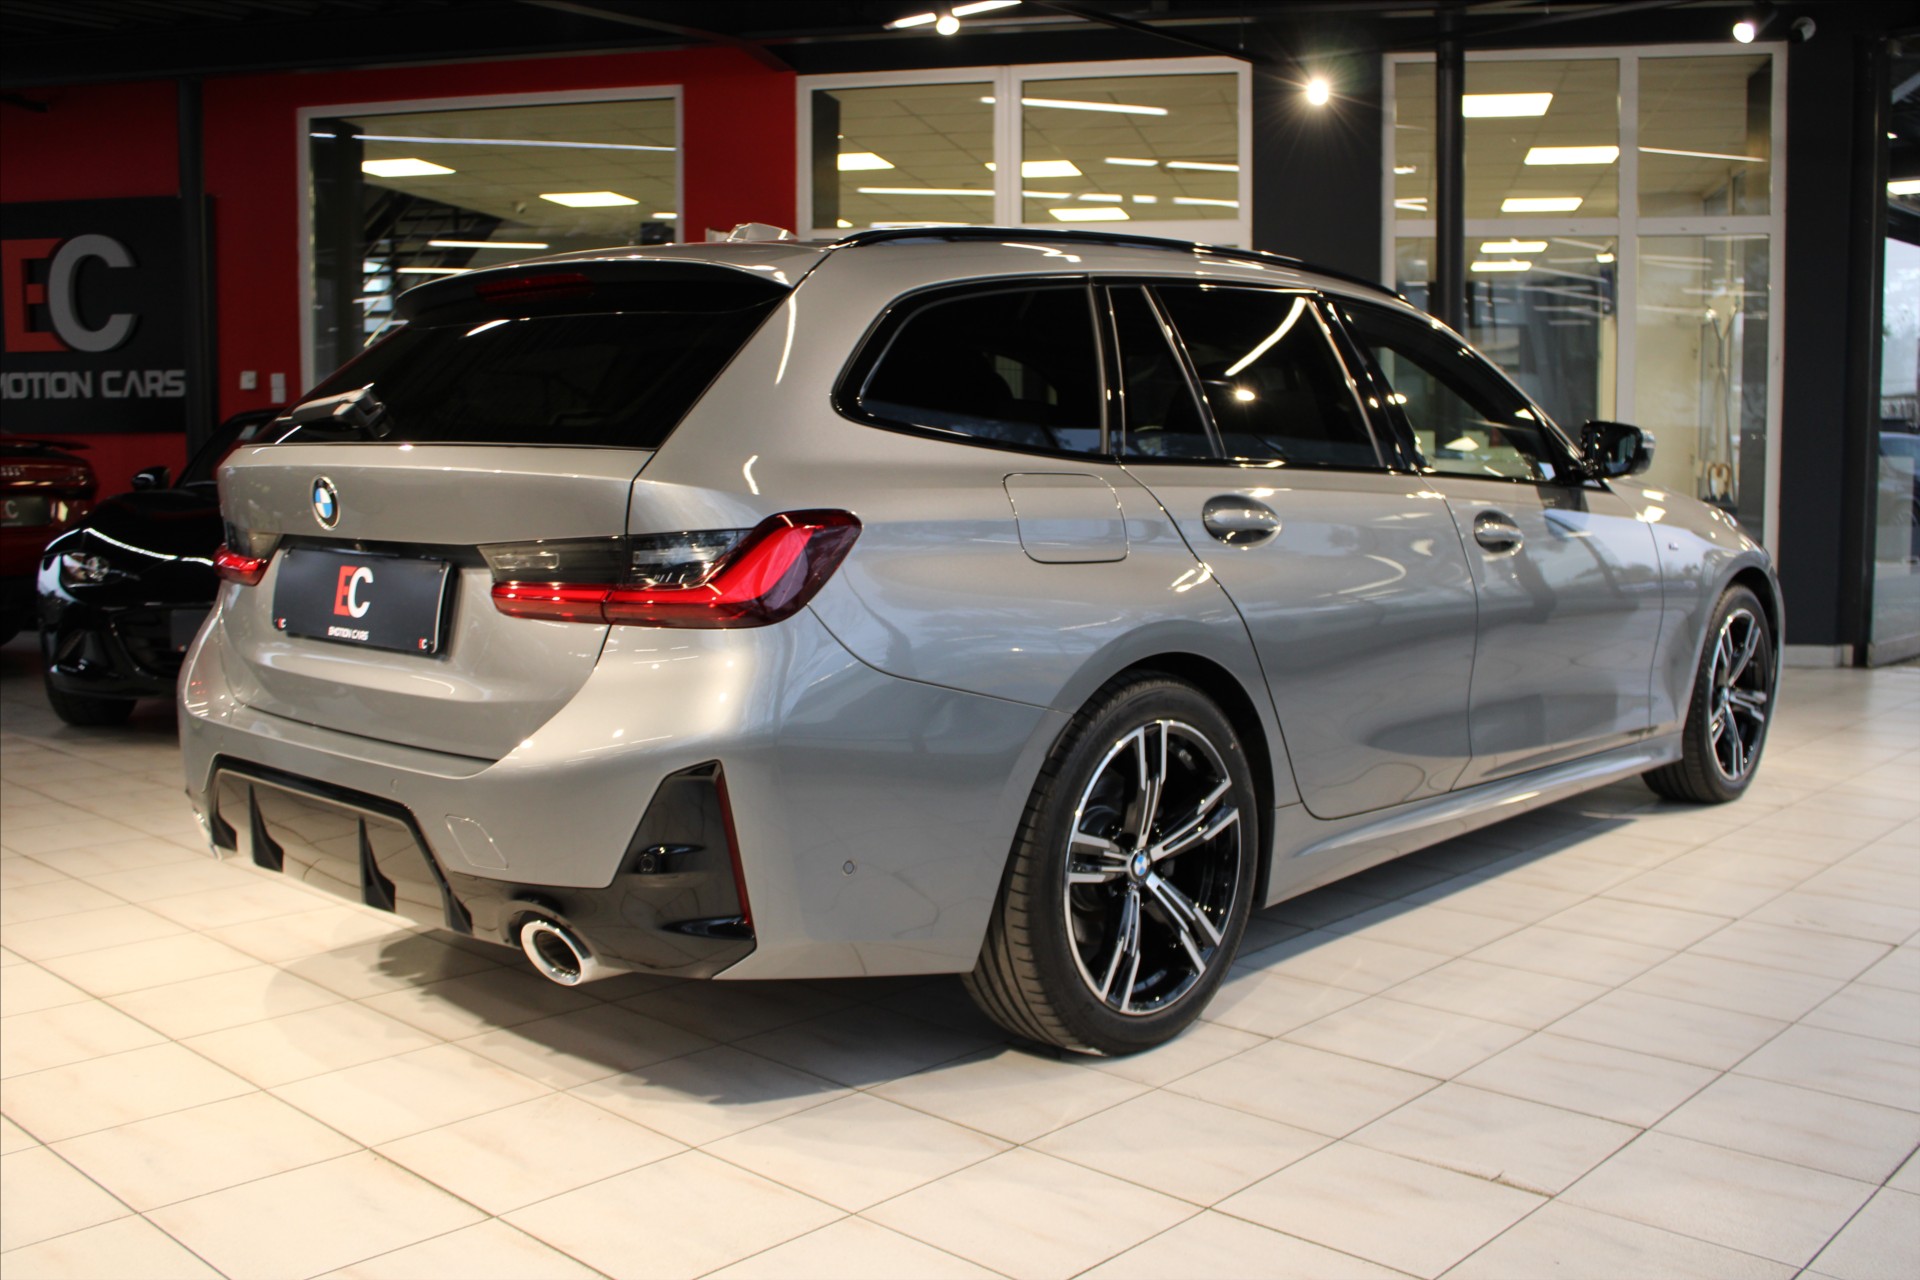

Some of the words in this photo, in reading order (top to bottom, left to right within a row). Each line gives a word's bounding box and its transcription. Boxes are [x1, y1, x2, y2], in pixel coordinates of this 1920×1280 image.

[2, 234, 137, 352] EC
[101, 370, 186, 398] CARS
[333, 565, 374, 619] EC
